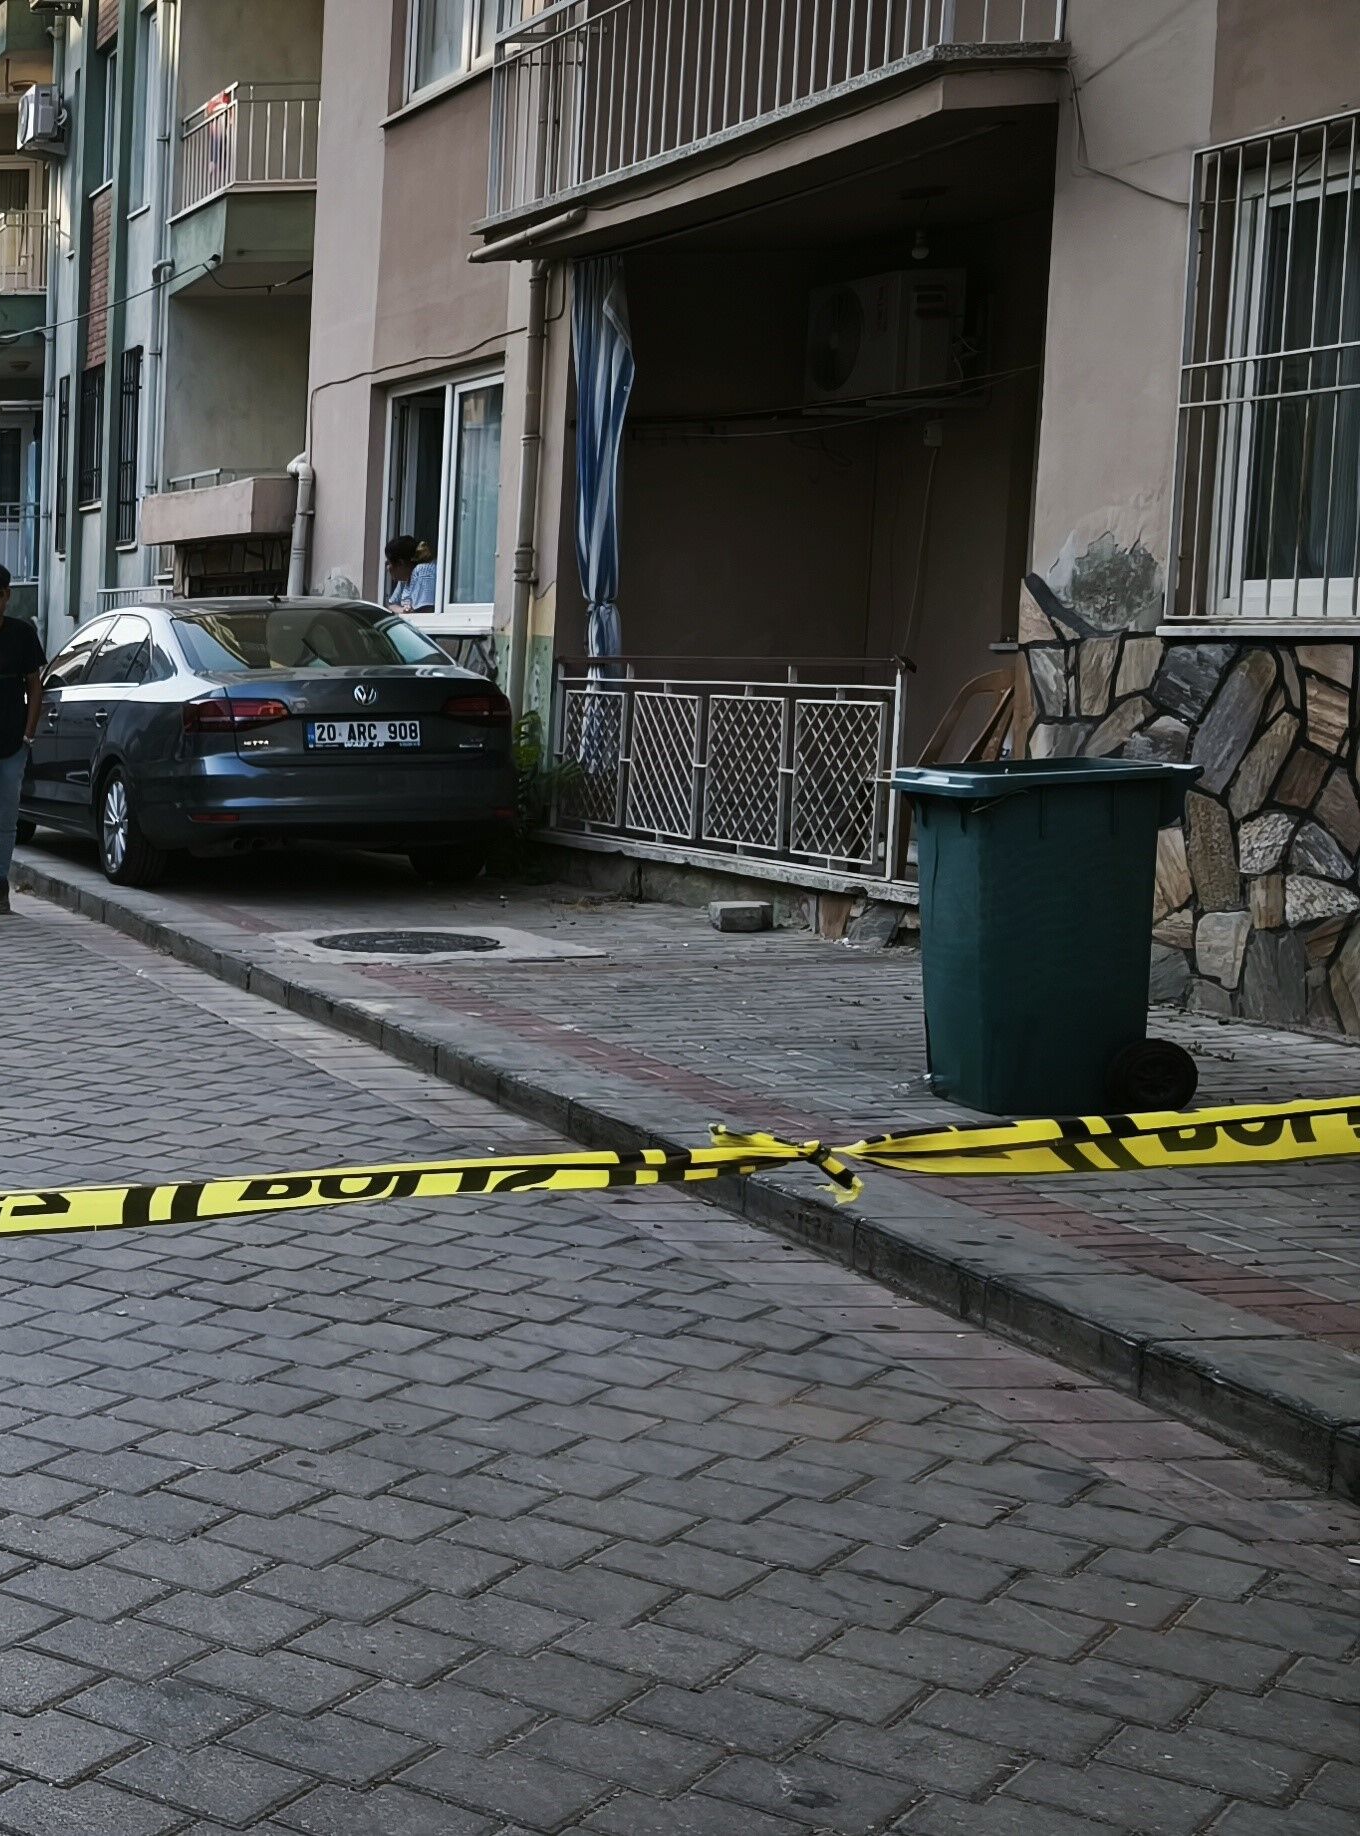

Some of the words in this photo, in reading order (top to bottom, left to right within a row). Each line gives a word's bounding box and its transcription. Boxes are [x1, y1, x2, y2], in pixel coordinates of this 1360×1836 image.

[316, 723, 336, 742] 20
[347, 723, 377, 741] ARC
[388, 722, 418, 740] 908
